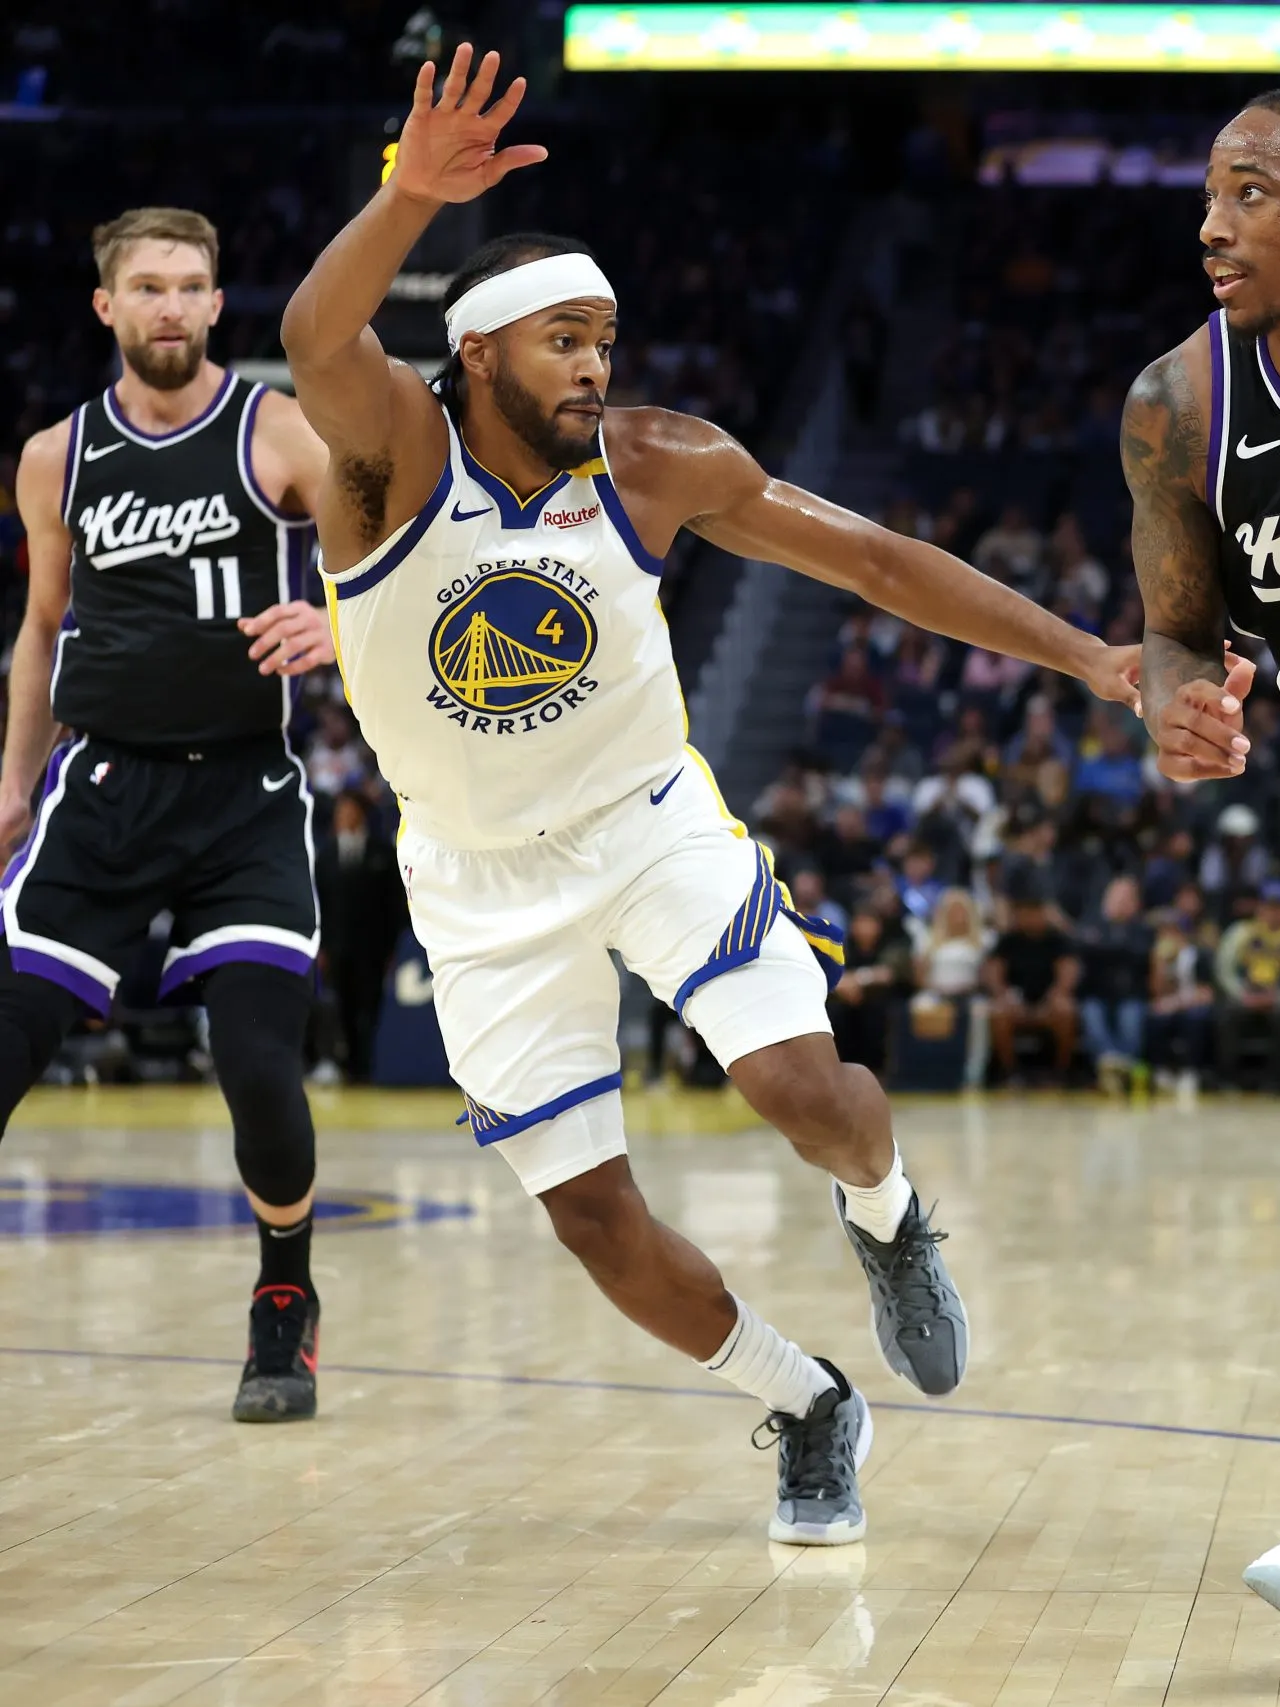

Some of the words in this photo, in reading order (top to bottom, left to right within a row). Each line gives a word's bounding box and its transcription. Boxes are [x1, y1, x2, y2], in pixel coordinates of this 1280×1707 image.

[78, 490, 241, 571] Kings
[189, 556, 242, 620] 11
[436, 560, 526, 604] GOLDEN
[537, 557, 600, 604] STATE
[536, 608, 564, 645] 4
[426, 675, 599, 735] WARRIORS
